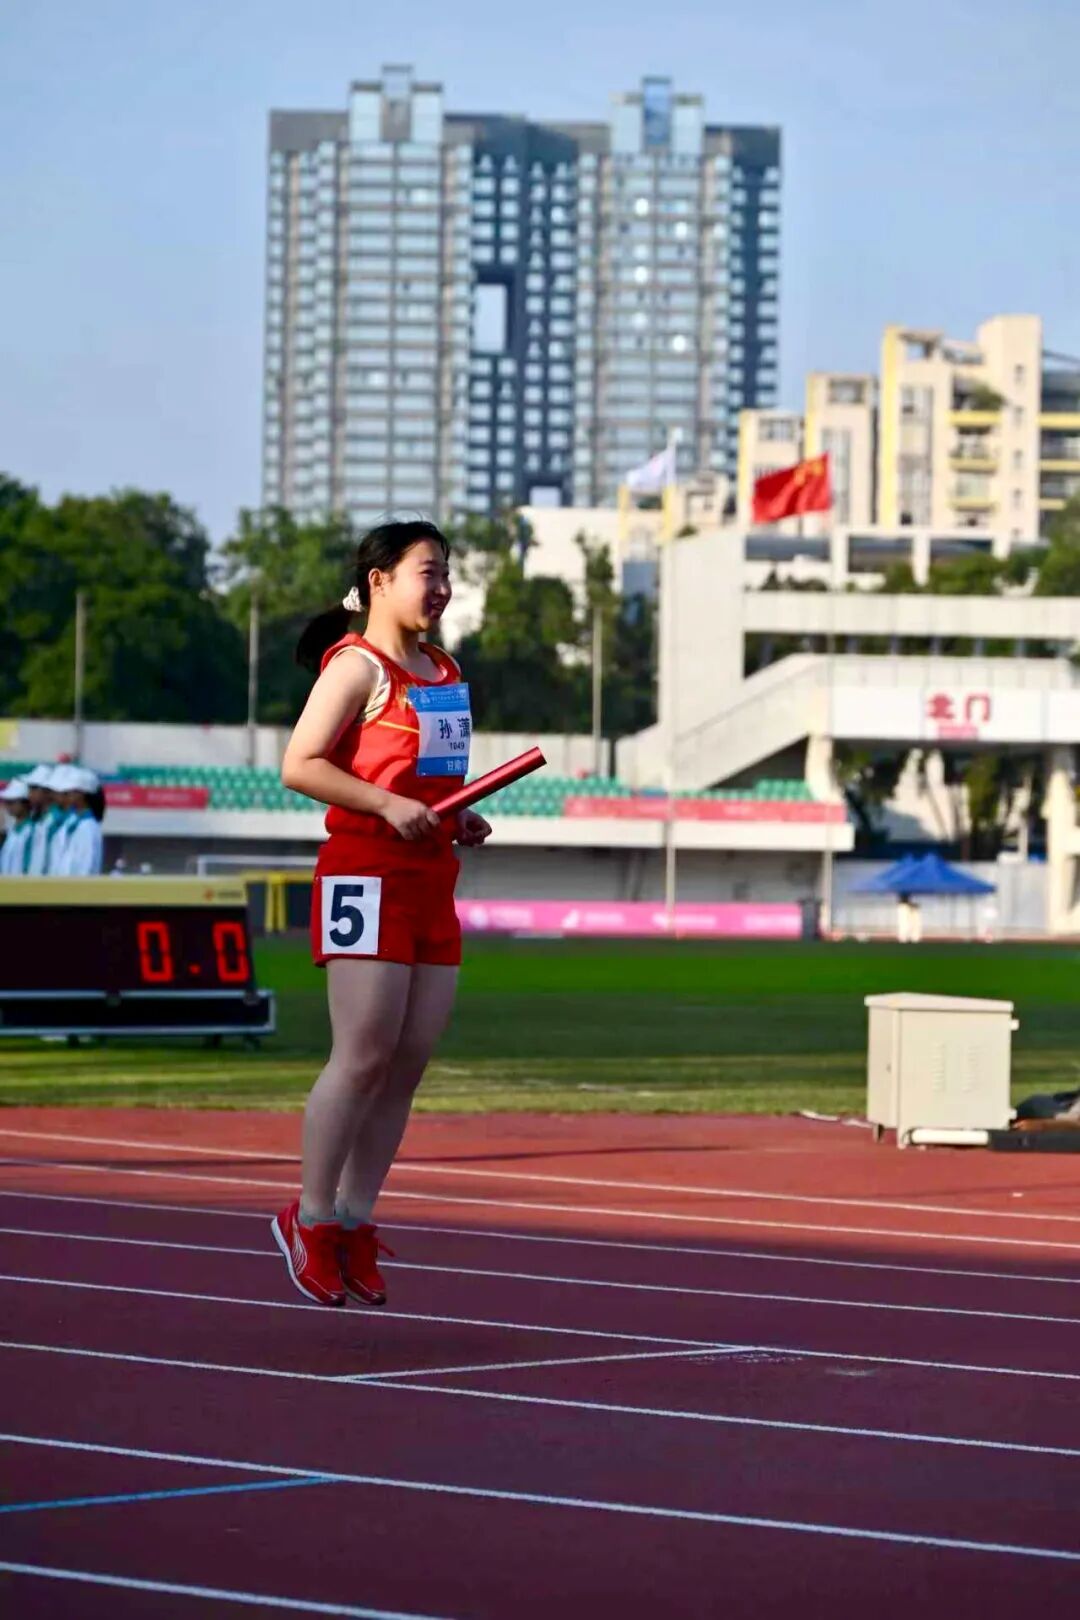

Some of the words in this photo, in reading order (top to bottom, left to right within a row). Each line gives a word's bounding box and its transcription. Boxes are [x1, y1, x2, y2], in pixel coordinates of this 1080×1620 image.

[928, 695, 990, 721] 北门
[449, 742, 465, 750] 1049
[330, 884, 364, 947] 5
[137, 921, 250, 981] 0.0
